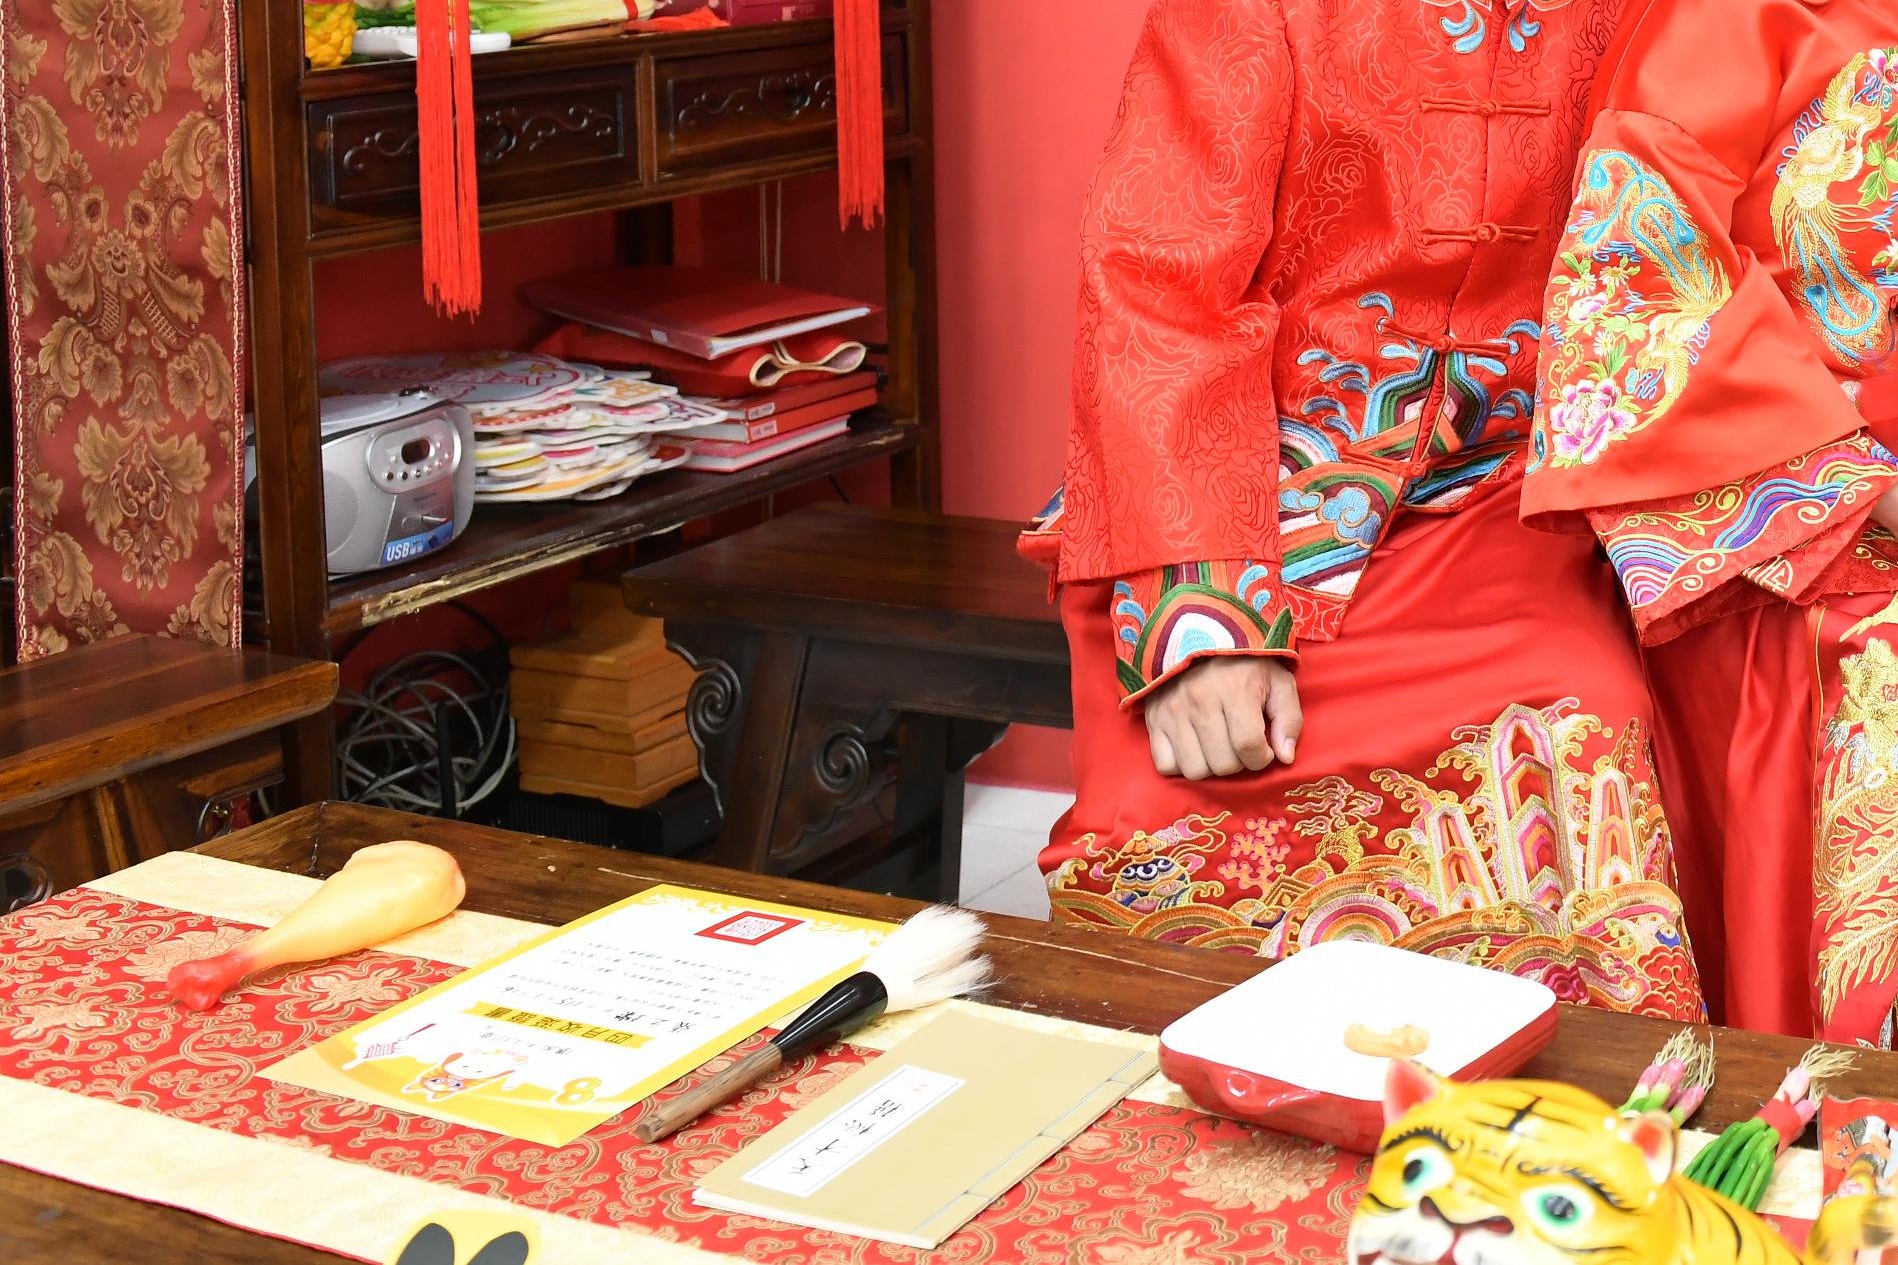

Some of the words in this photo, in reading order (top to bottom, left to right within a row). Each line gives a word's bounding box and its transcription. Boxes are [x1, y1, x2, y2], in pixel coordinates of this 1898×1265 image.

[386, 541, 410, 562] USB
[483, 1006, 634, 1045] 四月收涎證書
